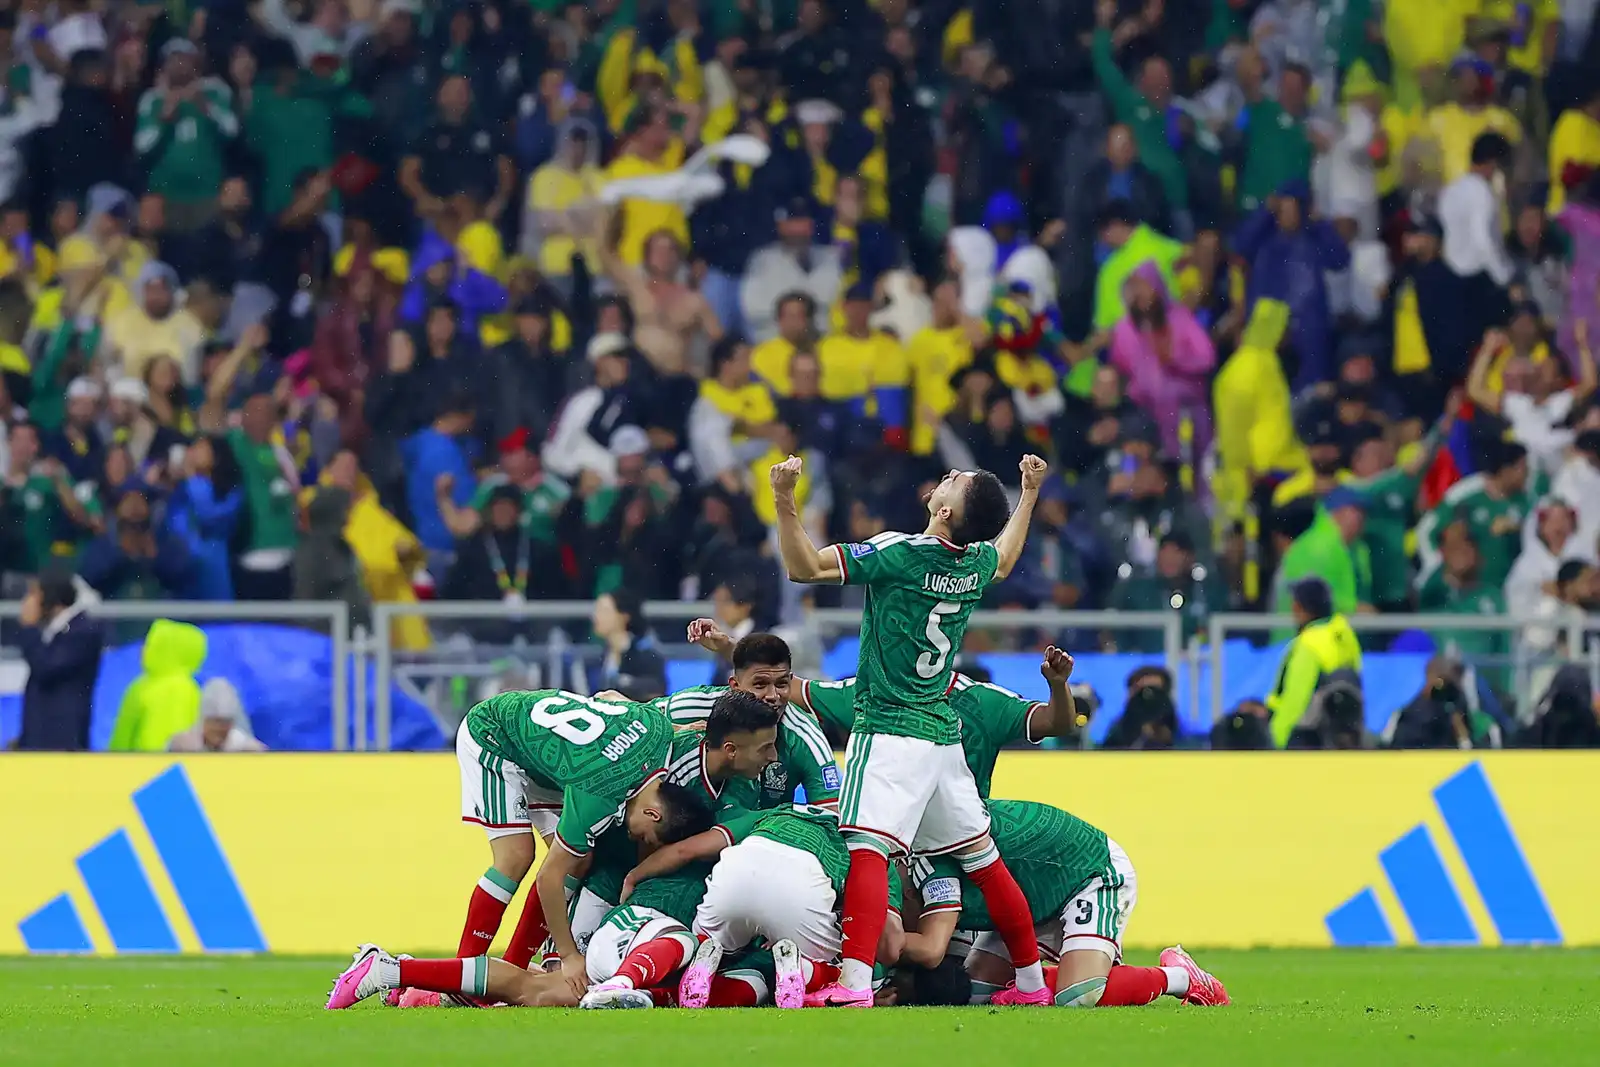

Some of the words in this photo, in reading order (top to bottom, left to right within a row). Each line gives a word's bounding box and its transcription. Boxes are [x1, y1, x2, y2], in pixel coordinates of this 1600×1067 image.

[915, 599, 961, 679] 5
[601, 720, 648, 761] G.MORA
[1075, 899, 1092, 925] 3
